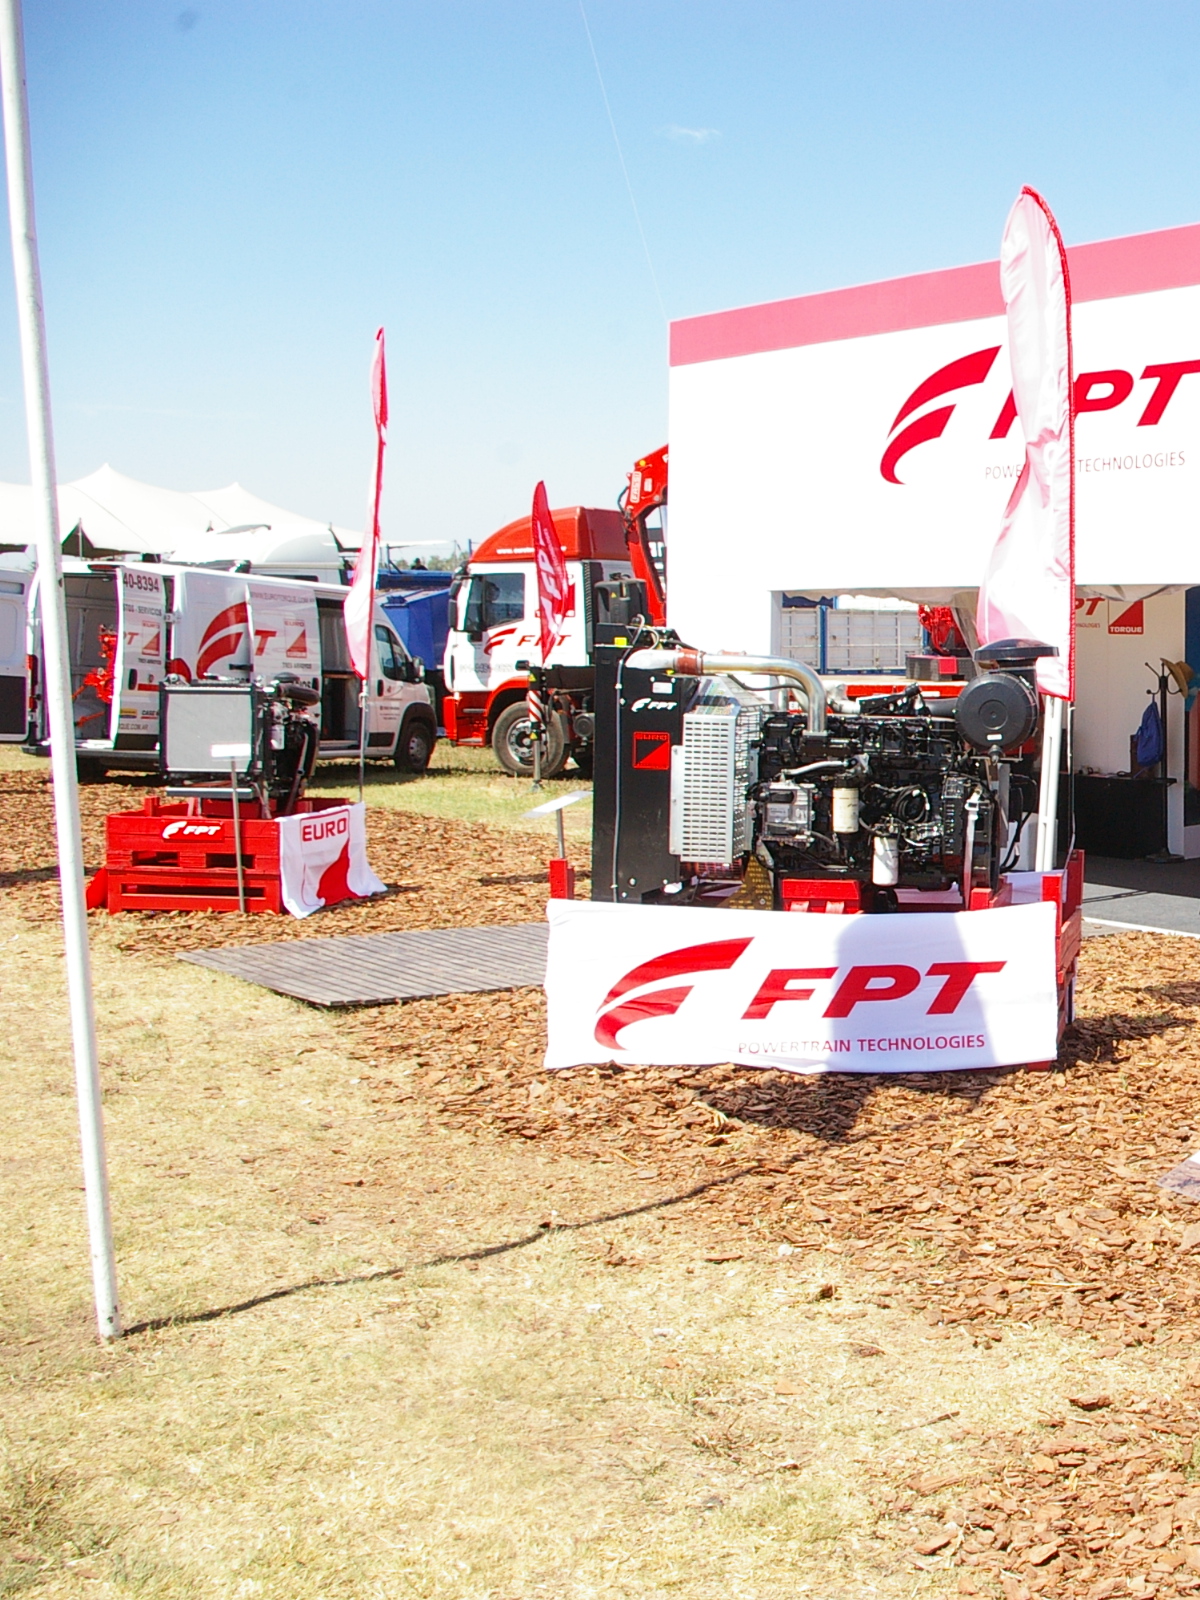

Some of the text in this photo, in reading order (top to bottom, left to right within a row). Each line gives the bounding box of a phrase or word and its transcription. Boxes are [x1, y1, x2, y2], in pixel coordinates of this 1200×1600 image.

[1077, 450, 1186, 474] TECHNOLOGIES
[517, 634, 571, 647] FT
[182, 824, 222, 836] FPT
[302, 817, 347, 842] EURO
[741, 961, 1005, 1019] FPT
[738, 1033, 986, 1055] POWERTRAIN TECHNOLOGIES
